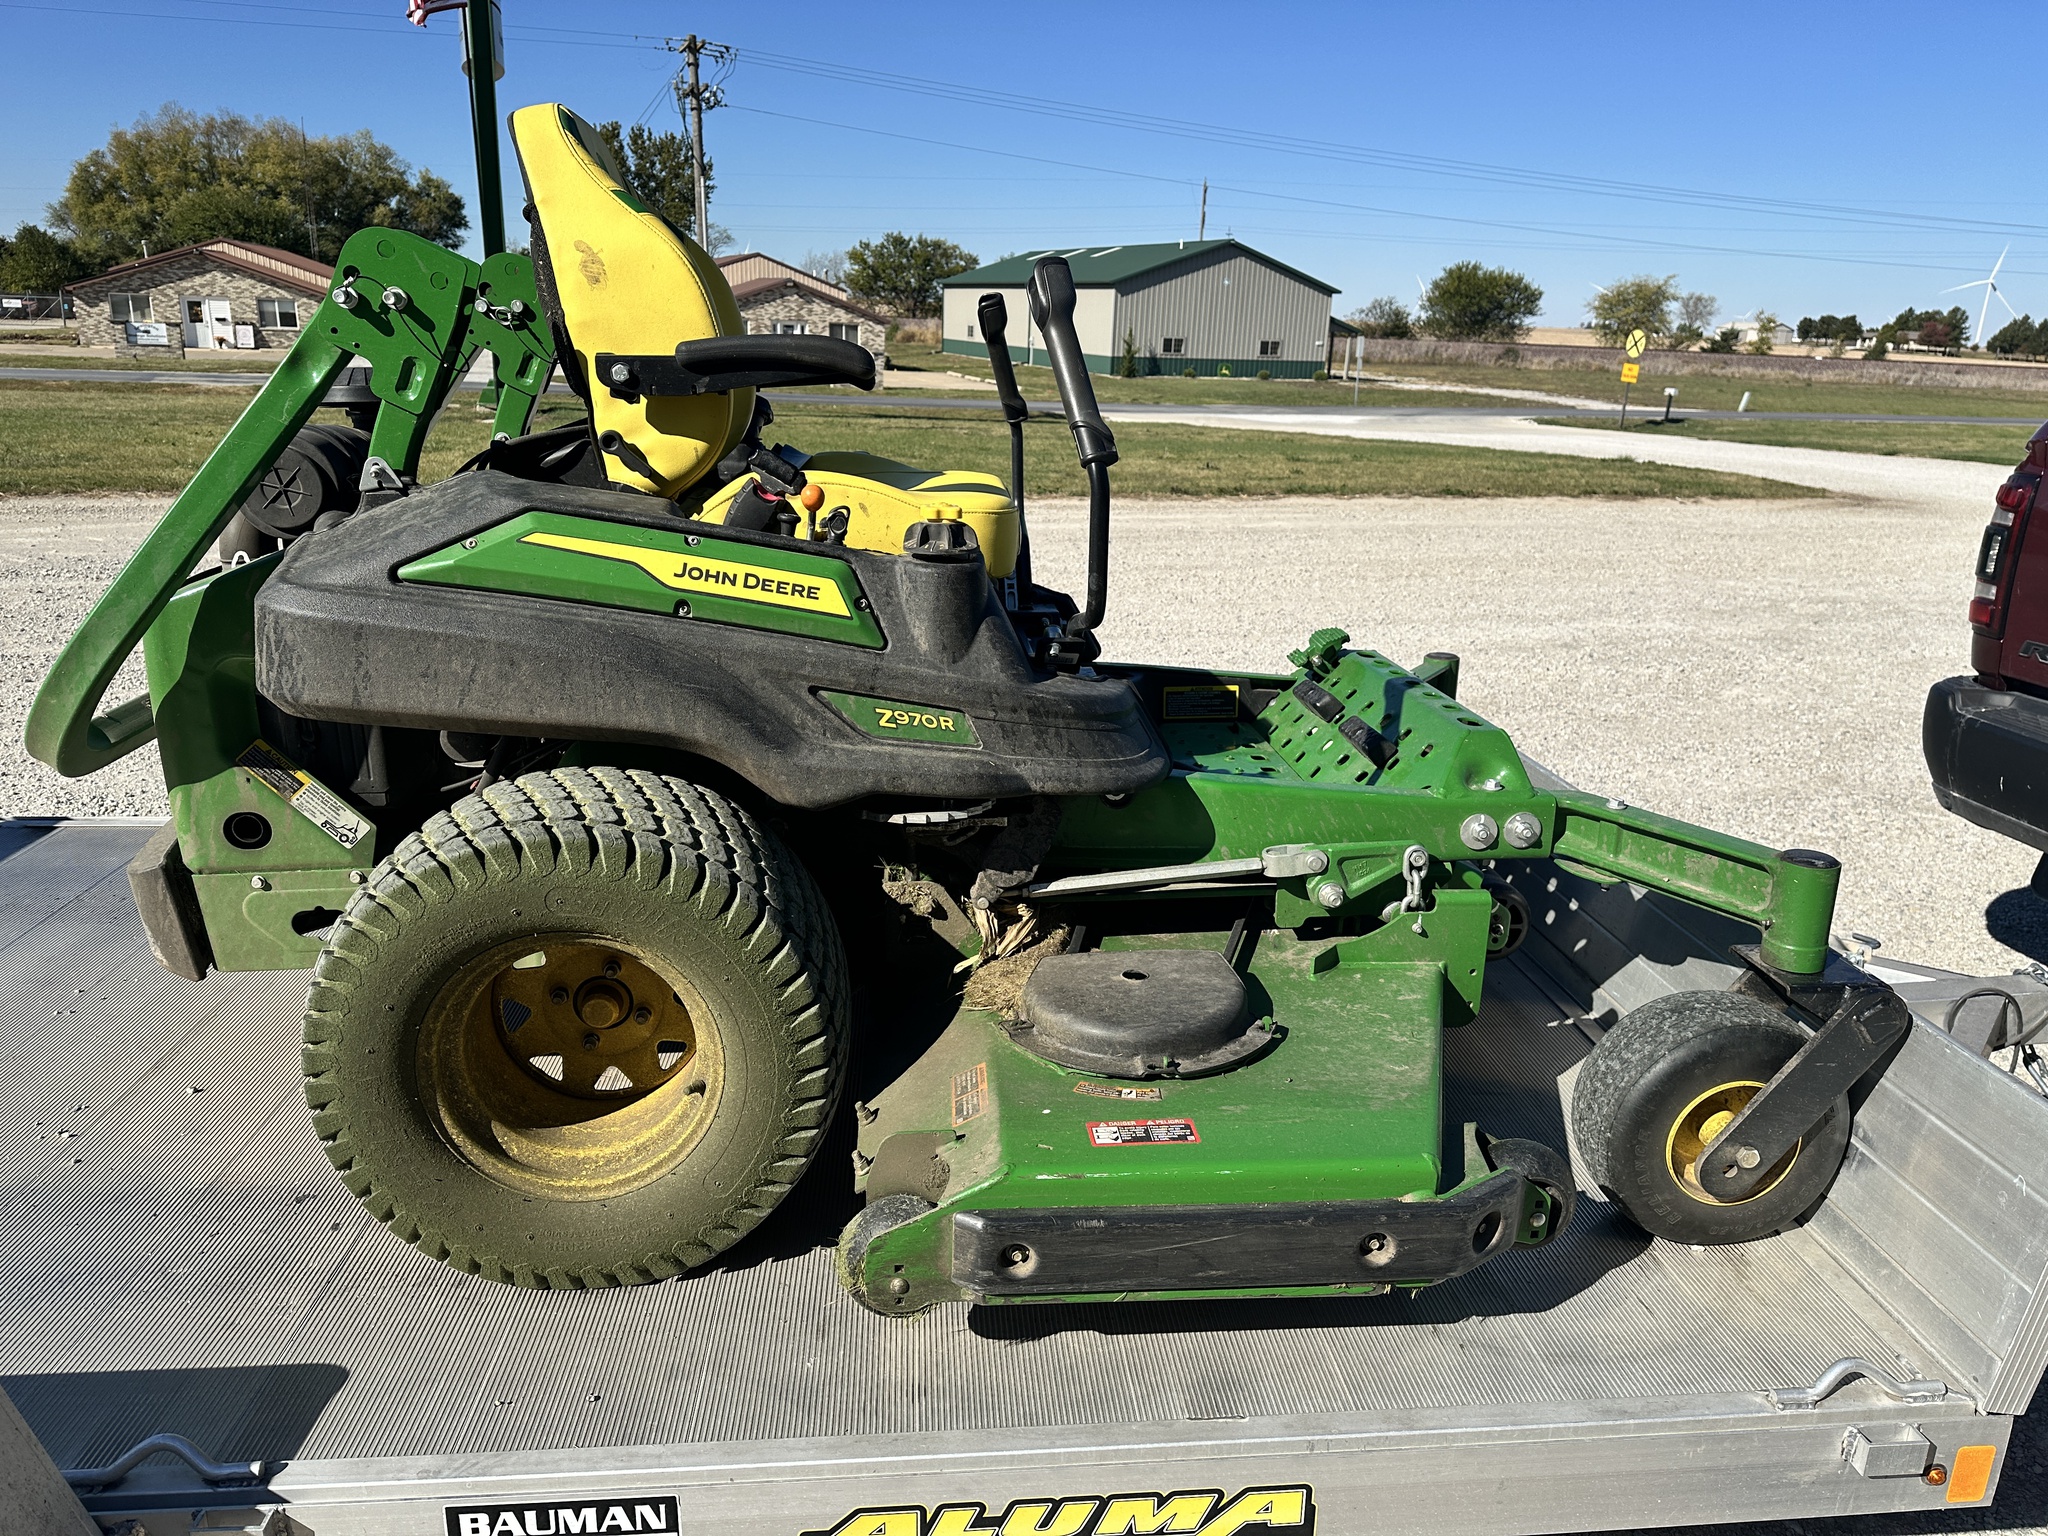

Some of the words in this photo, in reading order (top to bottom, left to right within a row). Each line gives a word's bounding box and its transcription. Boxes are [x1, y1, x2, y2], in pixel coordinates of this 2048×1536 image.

[673, 562, 738, 587] JOHN
[742, 572, 821, 600] DEERE
[874, 707, 957, 732] Z970R
[271, 752, 298, 775] CAUTION
[457, 1503, 668, 1536] BAUMAN
[828, 1488, 1307, 1536] ALUMA
